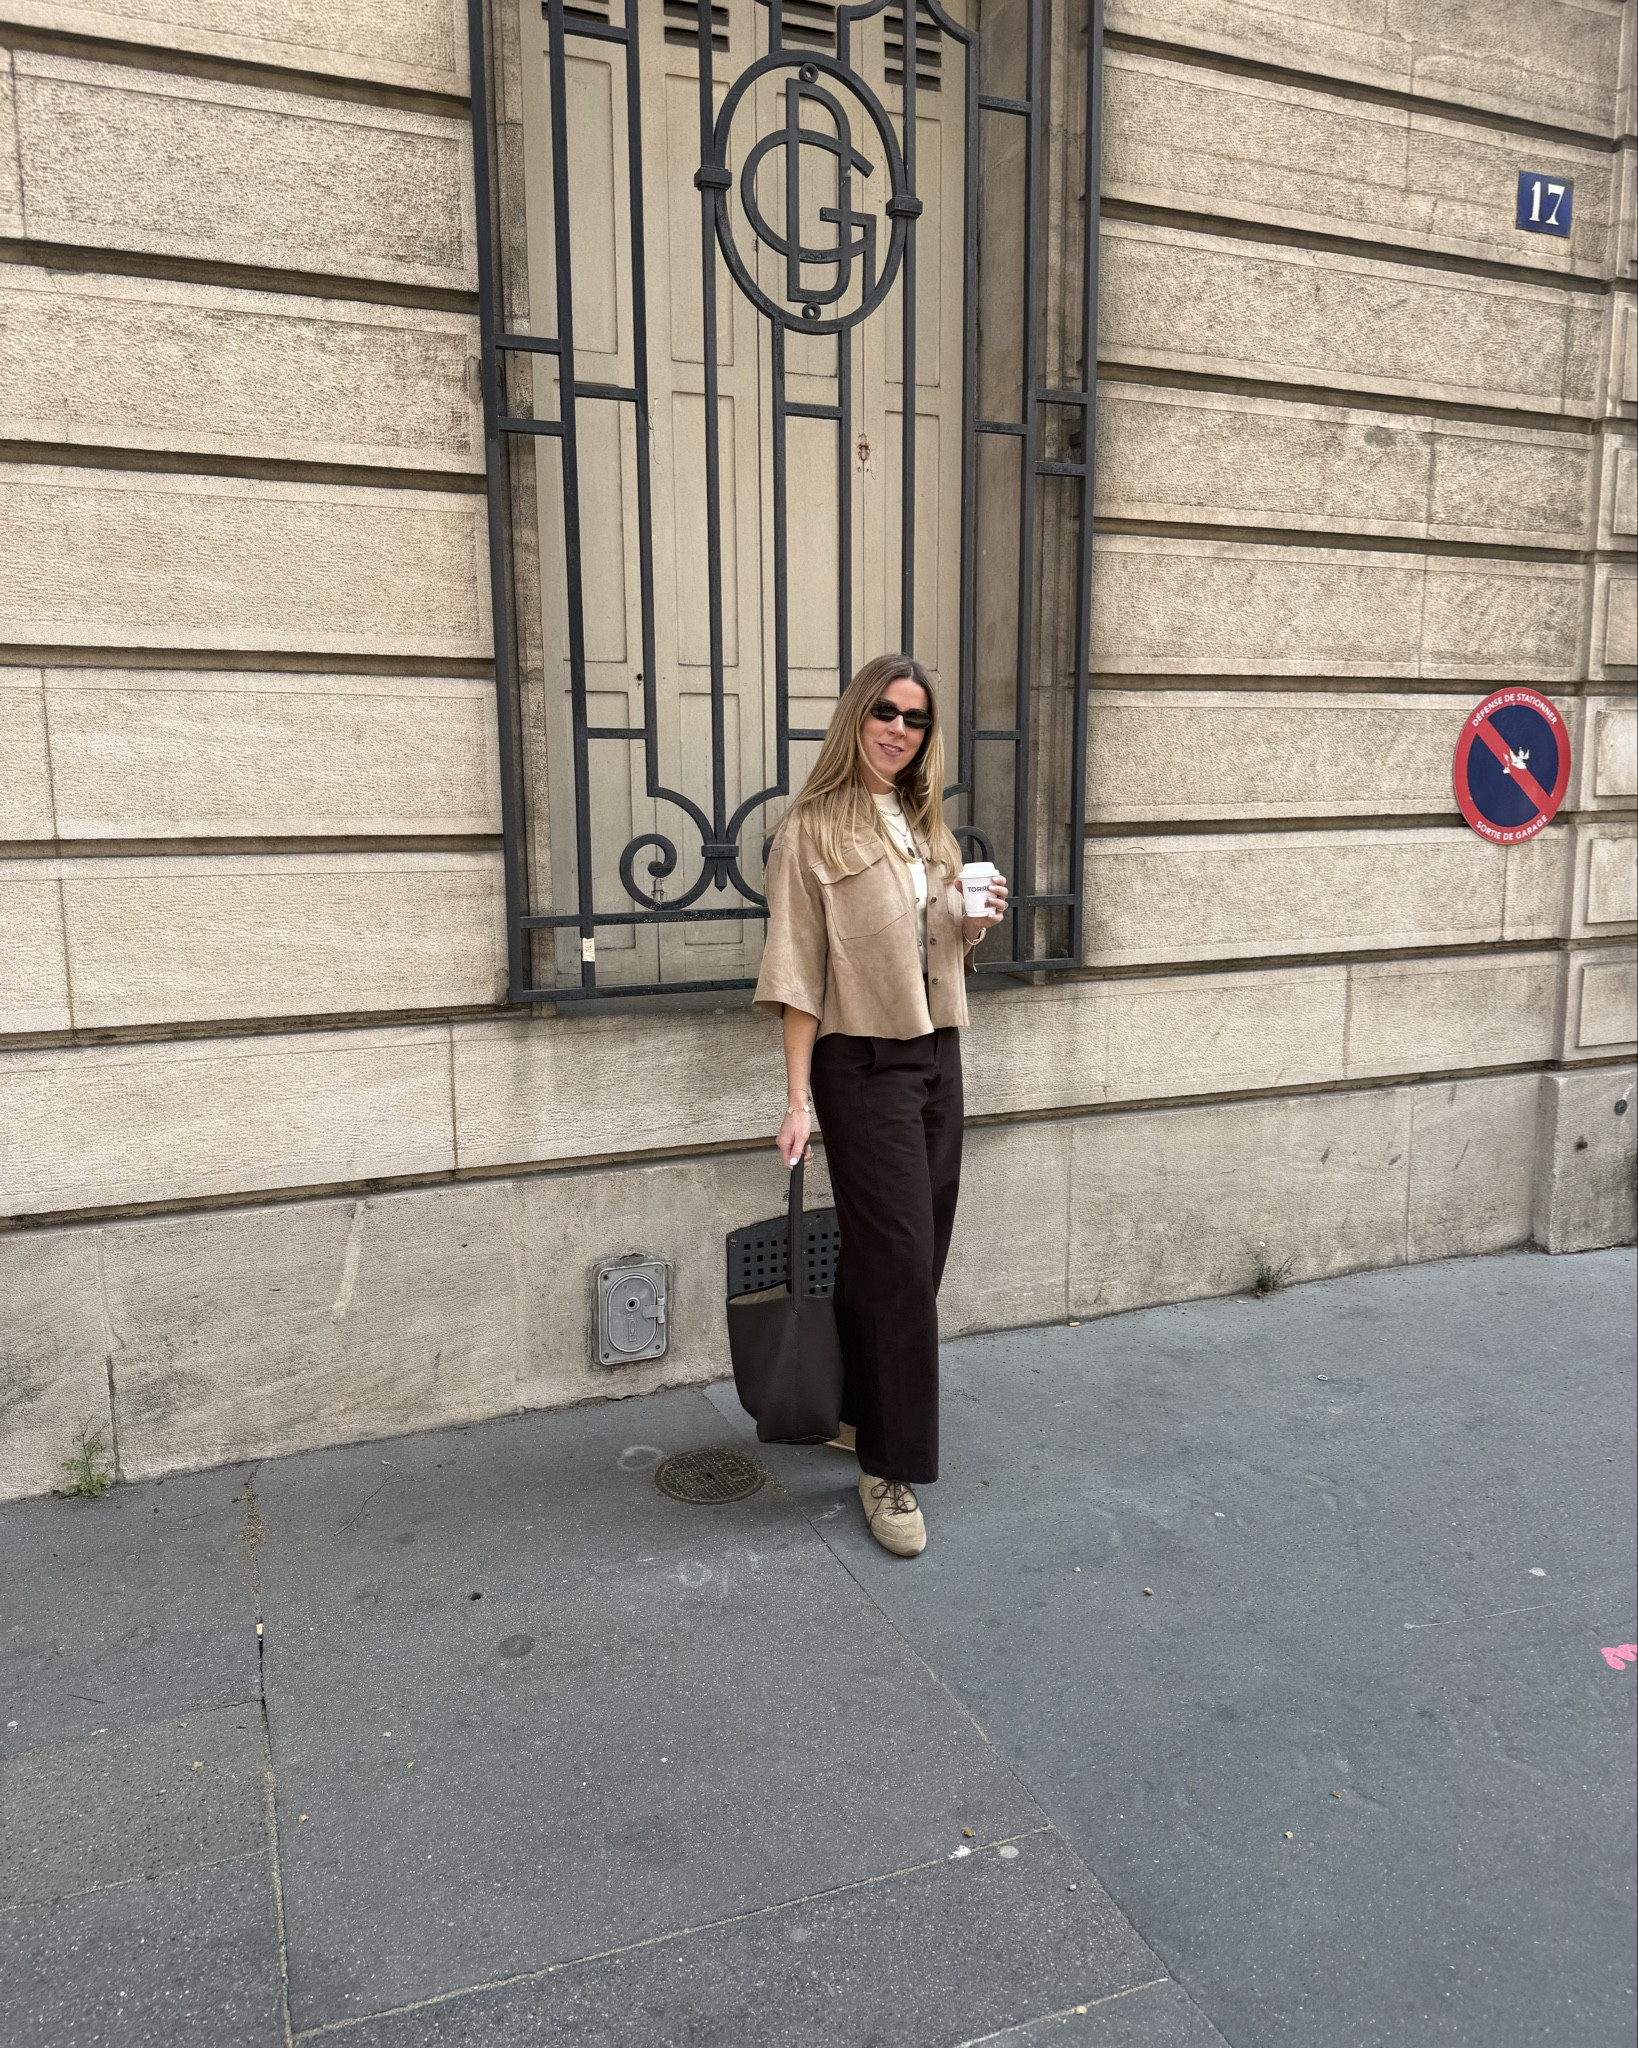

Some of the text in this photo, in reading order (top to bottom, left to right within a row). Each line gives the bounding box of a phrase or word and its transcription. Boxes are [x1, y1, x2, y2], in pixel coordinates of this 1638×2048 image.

[1529, 181, 1565, 225] 17
[1472, 693, 1558, 727] DÉFENSE DE STATIONNER
[1476, 814, 1548, 841] SORTIE DE GARAGE
